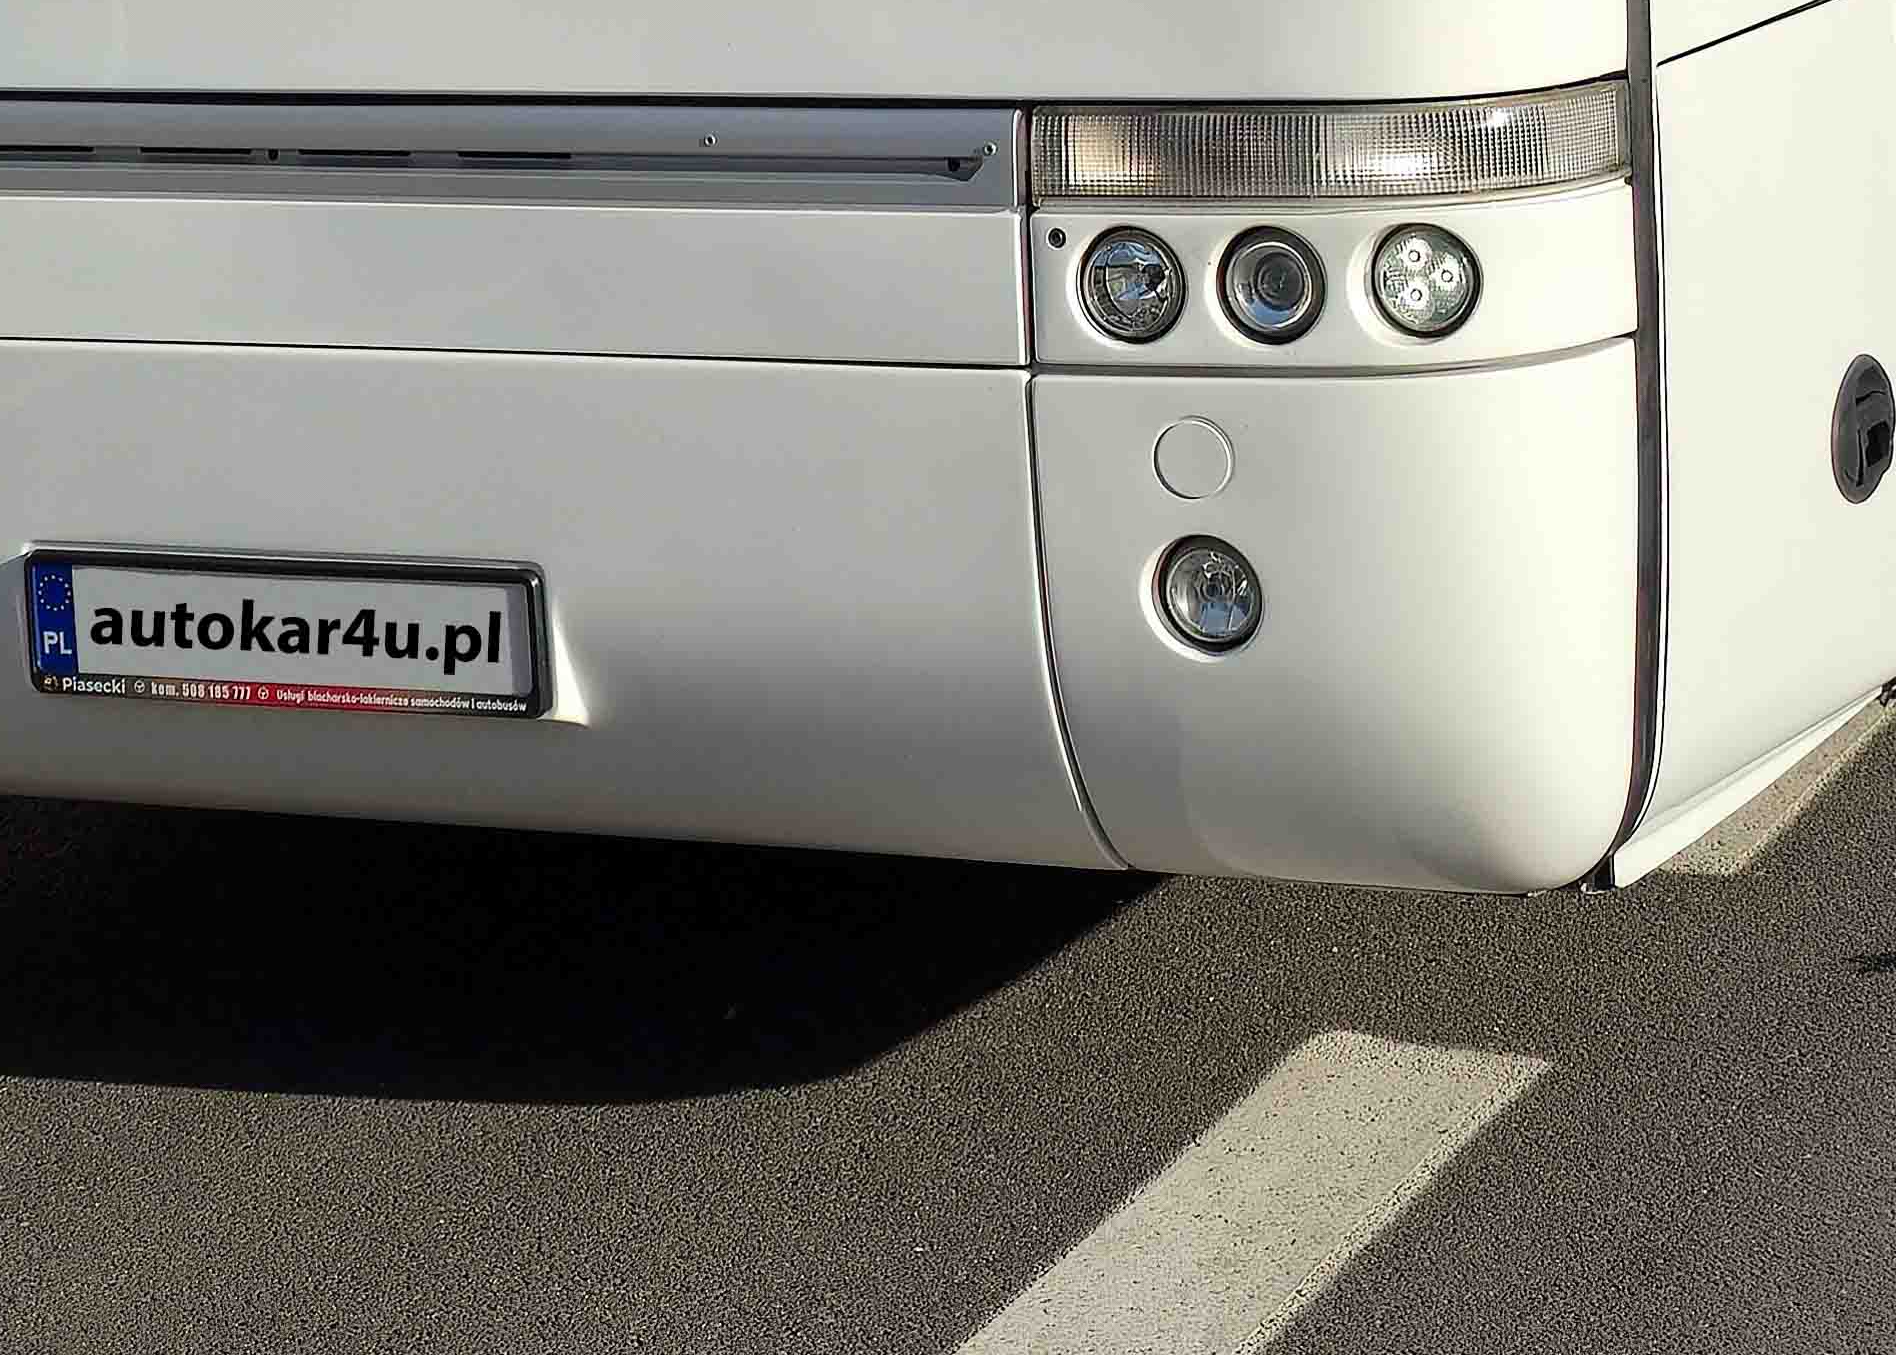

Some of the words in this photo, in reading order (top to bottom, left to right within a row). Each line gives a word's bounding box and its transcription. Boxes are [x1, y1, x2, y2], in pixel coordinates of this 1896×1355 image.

[43, 631, 72, 654] PL
[89, 599, 502, 676] autokar4u.pl
[62, 676, 126, 694] Piasecki
[151, 681, 180, 697] kom.
[182, 682, 205, 698] 508
[208, 684, 230, 699] 185
